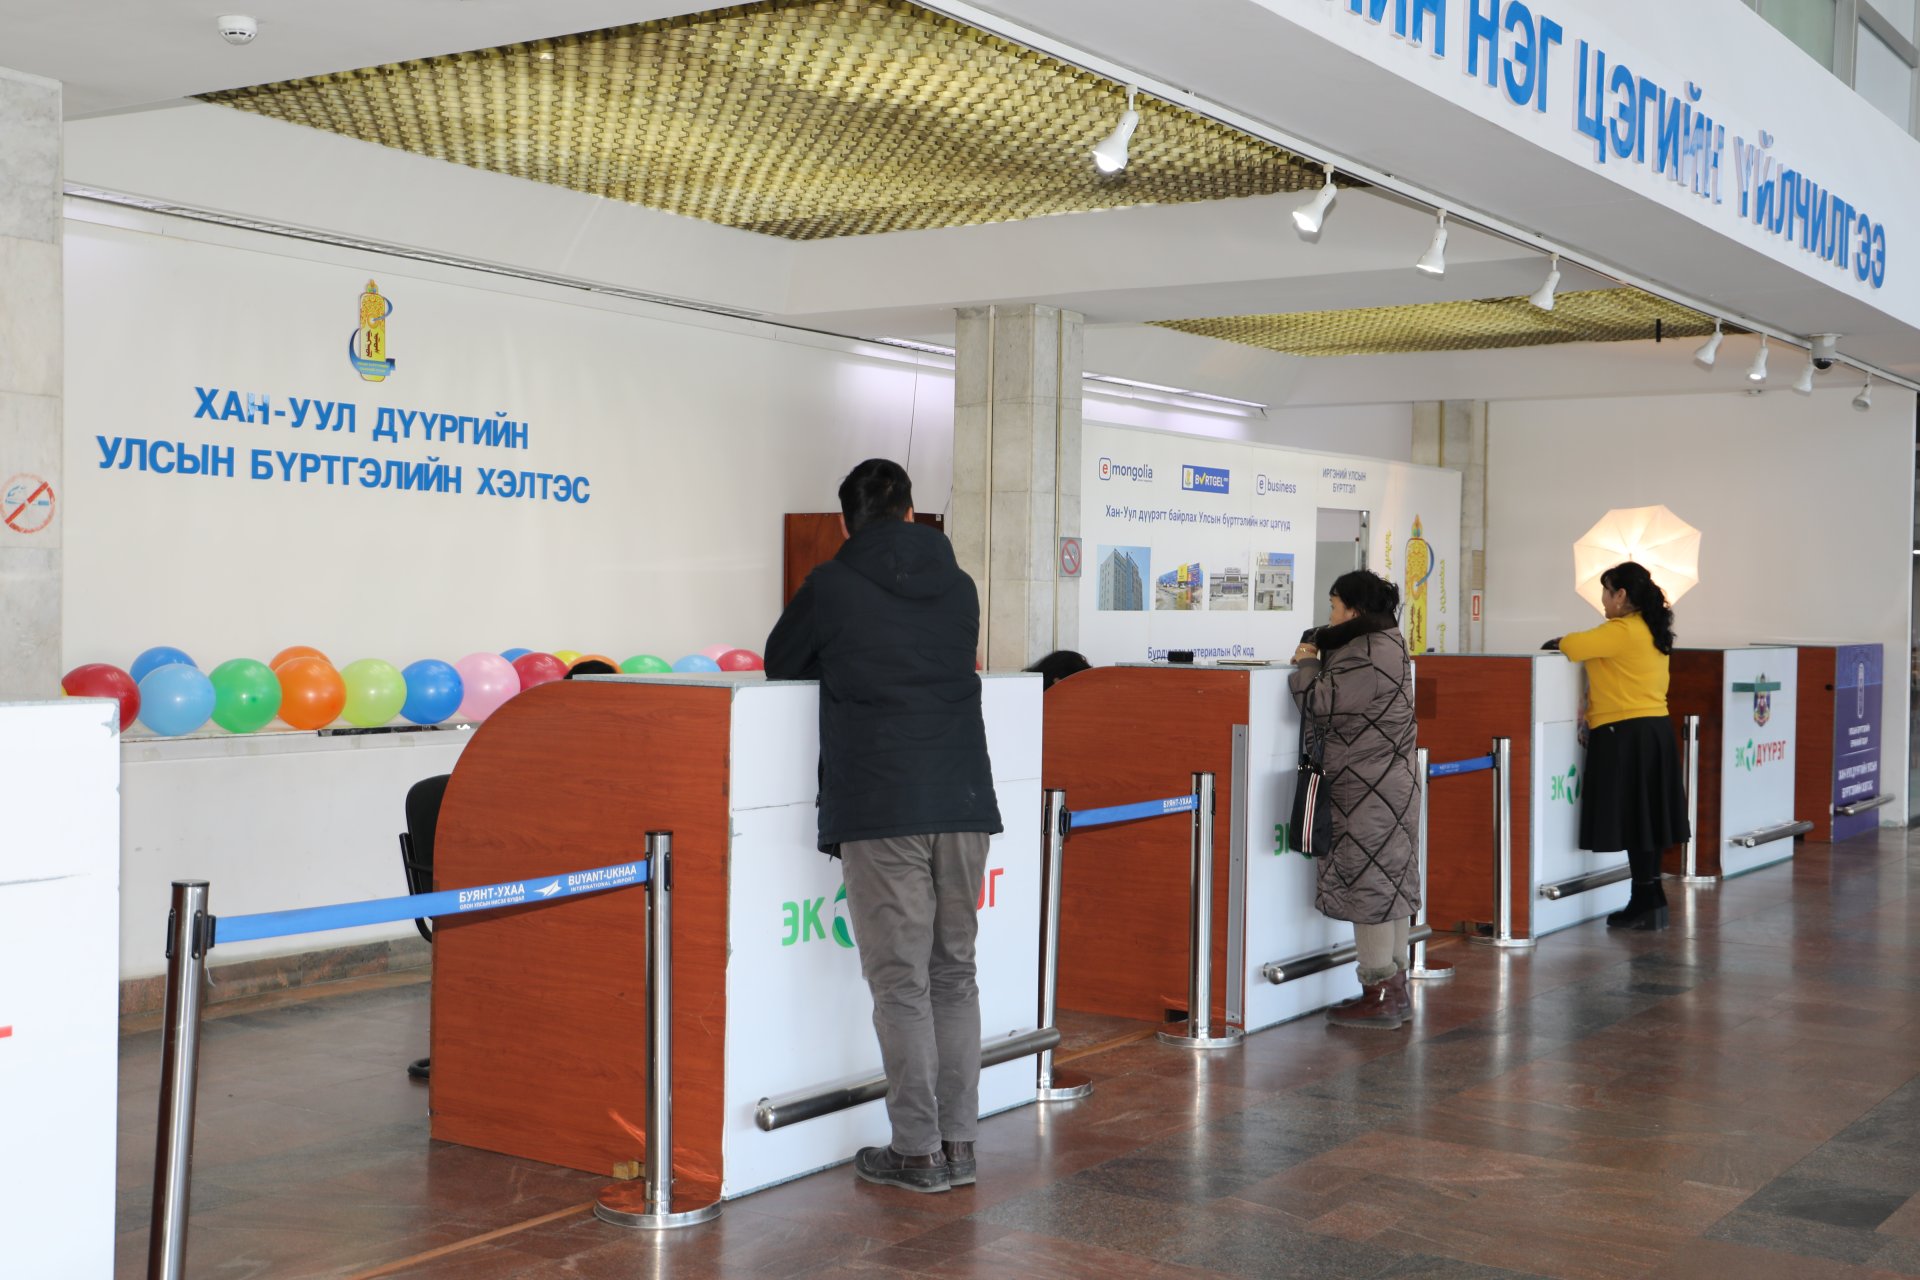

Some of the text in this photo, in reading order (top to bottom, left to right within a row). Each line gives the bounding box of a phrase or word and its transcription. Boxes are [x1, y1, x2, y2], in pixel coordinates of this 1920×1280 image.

[1463, 0, 1886, 289] НЭГ ЦЭГИЙН ҮЙЛЧИЛГЭЭ
[194, 386, 528, 449] ХАН-УУЛ ДҮҮРГИЙН
[97, 435, 590, 503] УЛСЫН БҮРТГЭЛИЙН ХЭЛТЭС
[1112, 464, 1153, 481] mongolia
[1322, 468, 1366, 481] ИРГЭНИЙ УЛСЫН
[1268, 480, 1296, 494] business
[1105, 504, 1137, 523] Хан-Уул
[1138, 509, 1167, 523] дүүрэгт
[1168, 509, 1197, 525] байрлах
[1198, 511, 1221, 524] Улсын
[1243, 647, 1255, 658] код
[568, 865, 637, 886] BUYANT-UKHAA
[570, 876, 635, 892] INTERNATIONAL AIRPORT
[459, 884, 525, 903] БУЯНТ-УХАА
